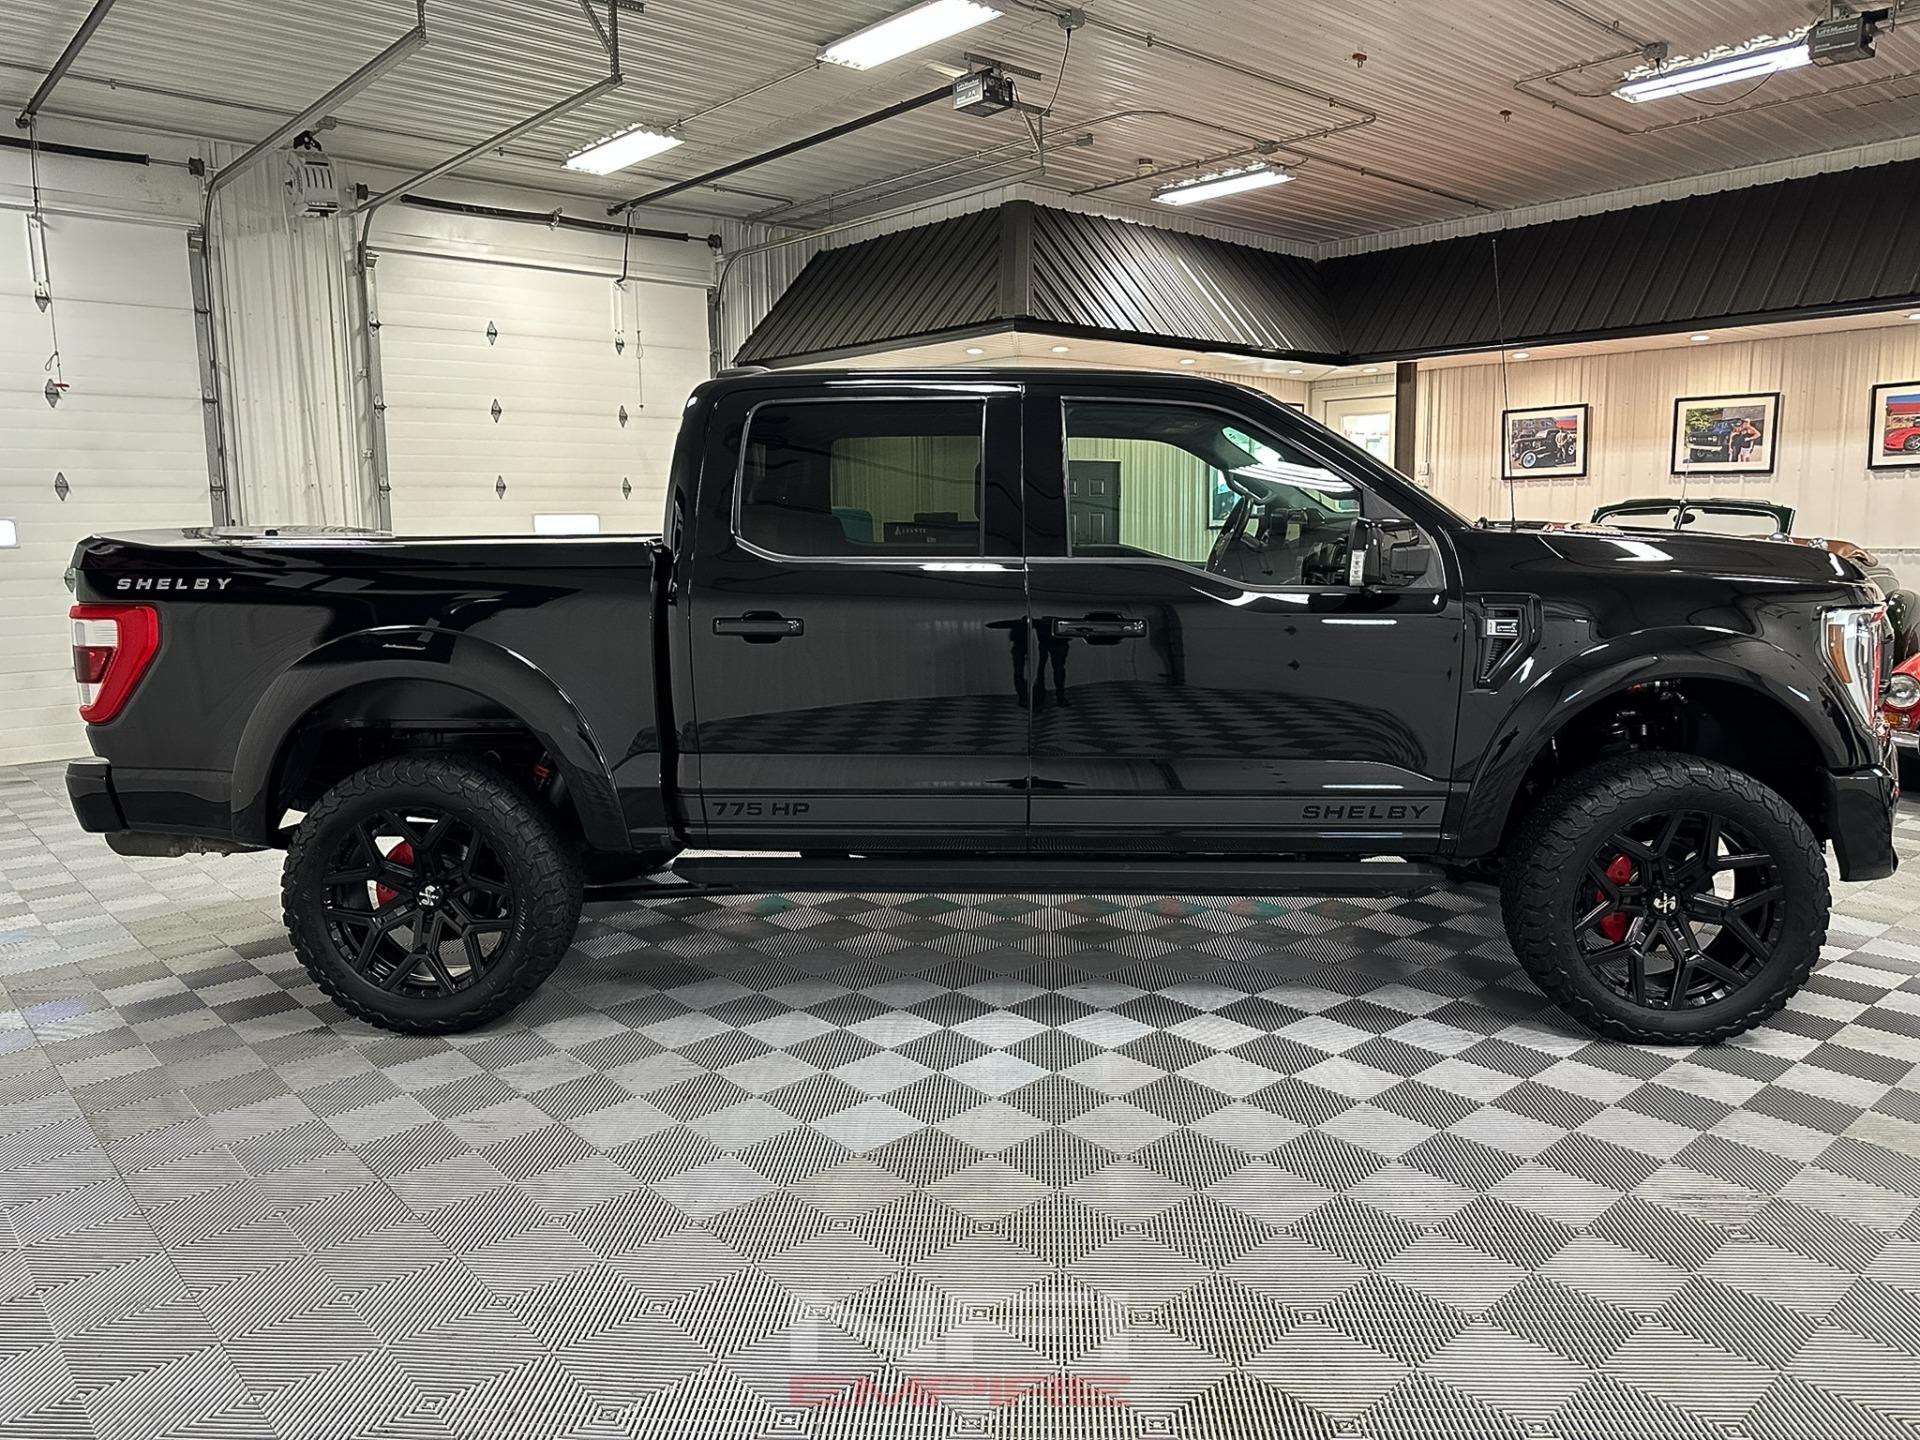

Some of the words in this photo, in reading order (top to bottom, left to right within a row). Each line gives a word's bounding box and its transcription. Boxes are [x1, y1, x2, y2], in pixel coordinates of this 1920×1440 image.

[116, 578, 232, 590] SHELBY
[712, 802, 763, 816] 775
[771, 802, 810, 816] HP
[1301, 805, 1430, 819] SHELBY
